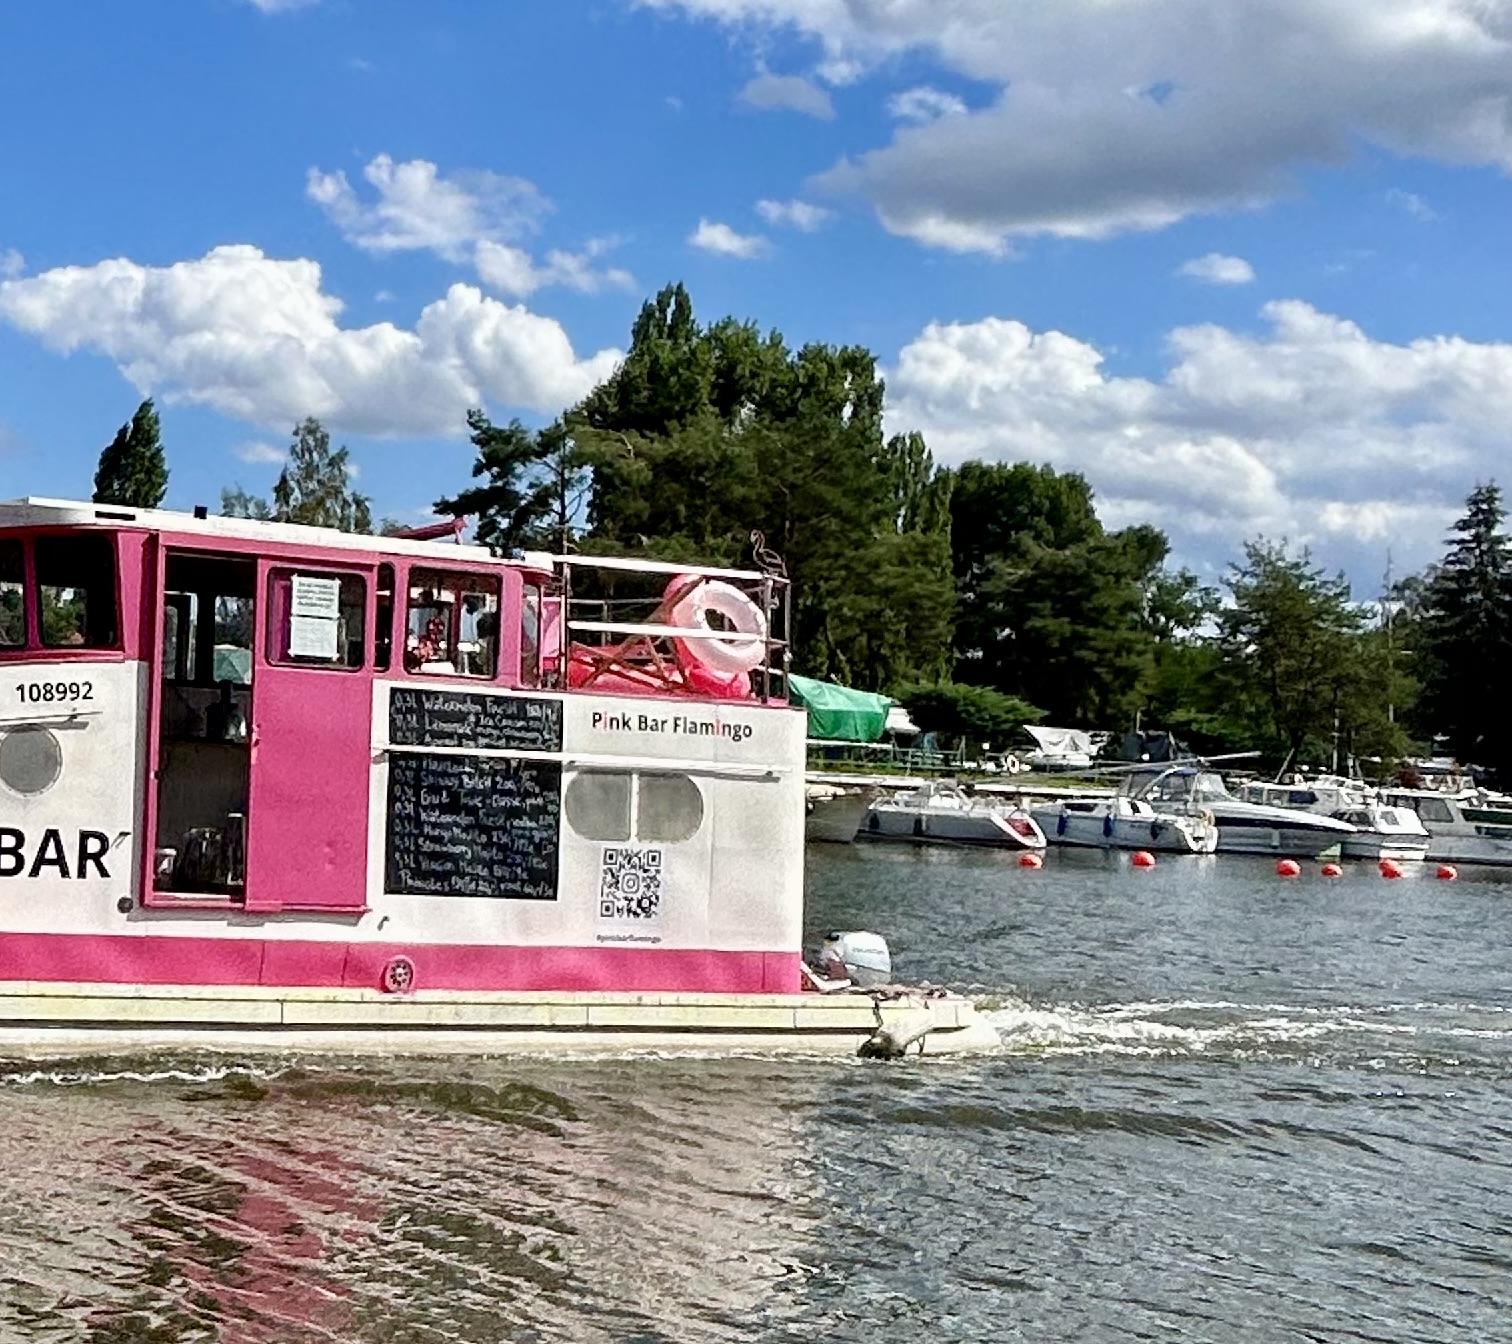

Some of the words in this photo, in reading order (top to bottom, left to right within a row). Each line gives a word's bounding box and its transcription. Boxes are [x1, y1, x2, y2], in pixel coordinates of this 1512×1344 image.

[16, 681, 94, 703] 108992
[592, 711, 633, 732] Pink
[637, 714, 669, 734] Bar
[673, 716, 753, 743] Flamingo
